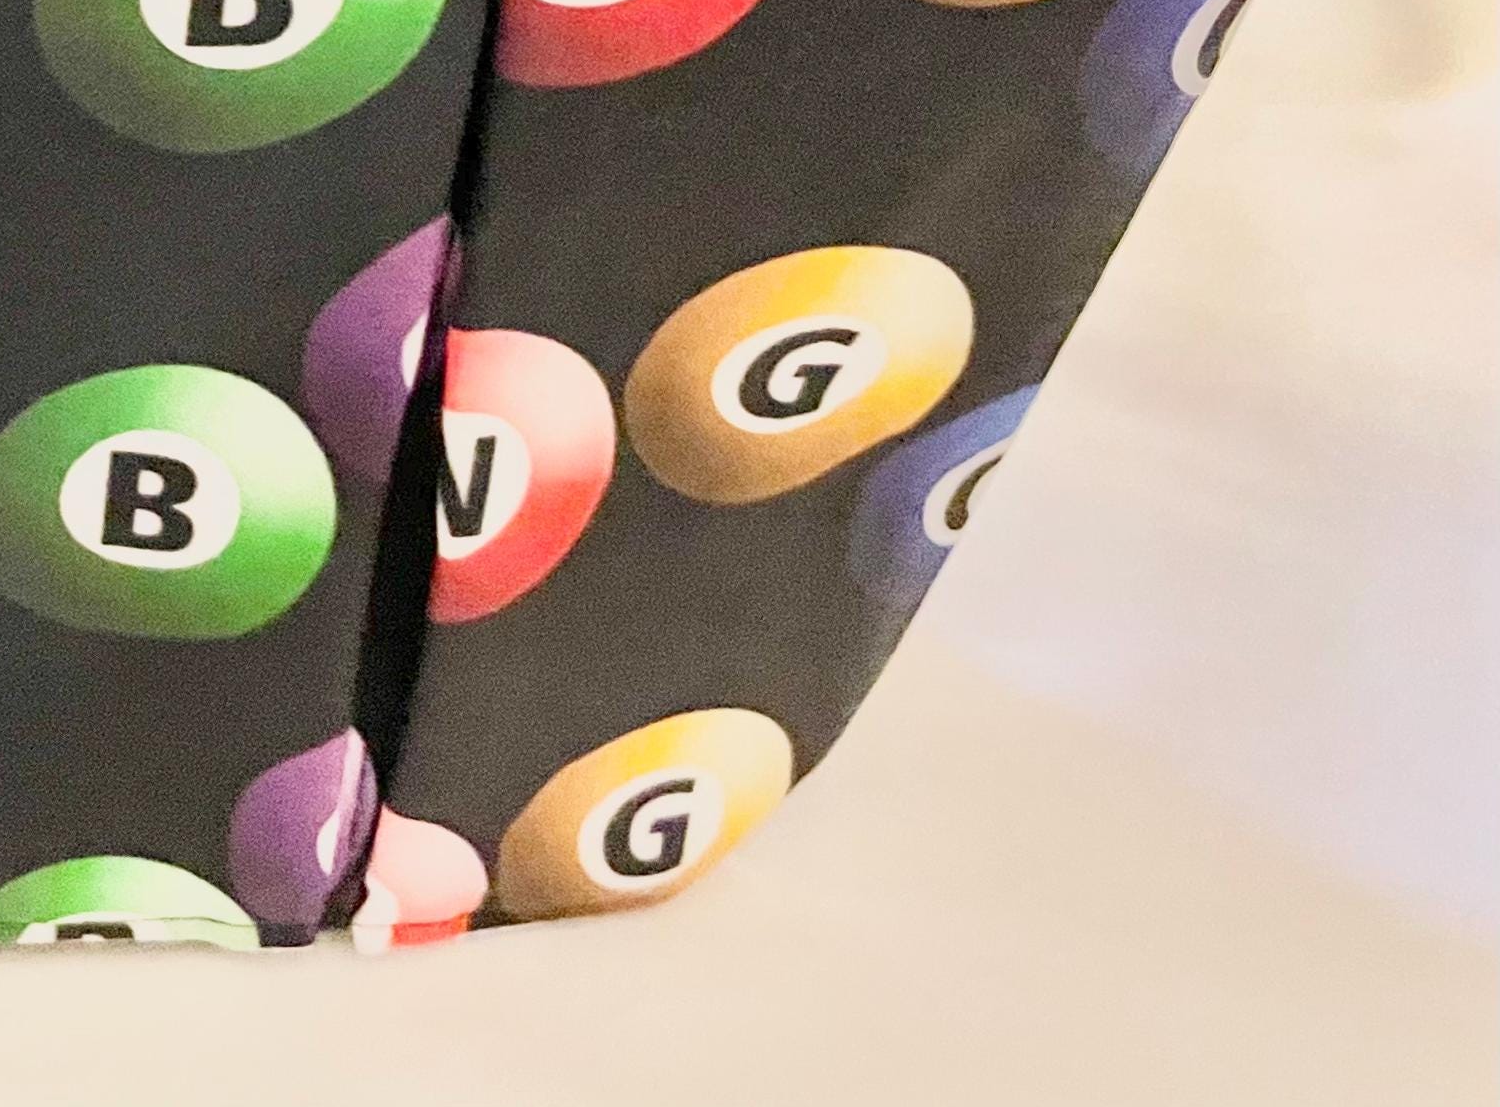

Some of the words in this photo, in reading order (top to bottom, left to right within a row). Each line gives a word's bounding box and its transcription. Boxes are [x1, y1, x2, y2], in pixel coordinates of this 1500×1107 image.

[737, 328, 860, 419] G
[101, 450, 201, 552] B
[601, 778, 696, 878] G
